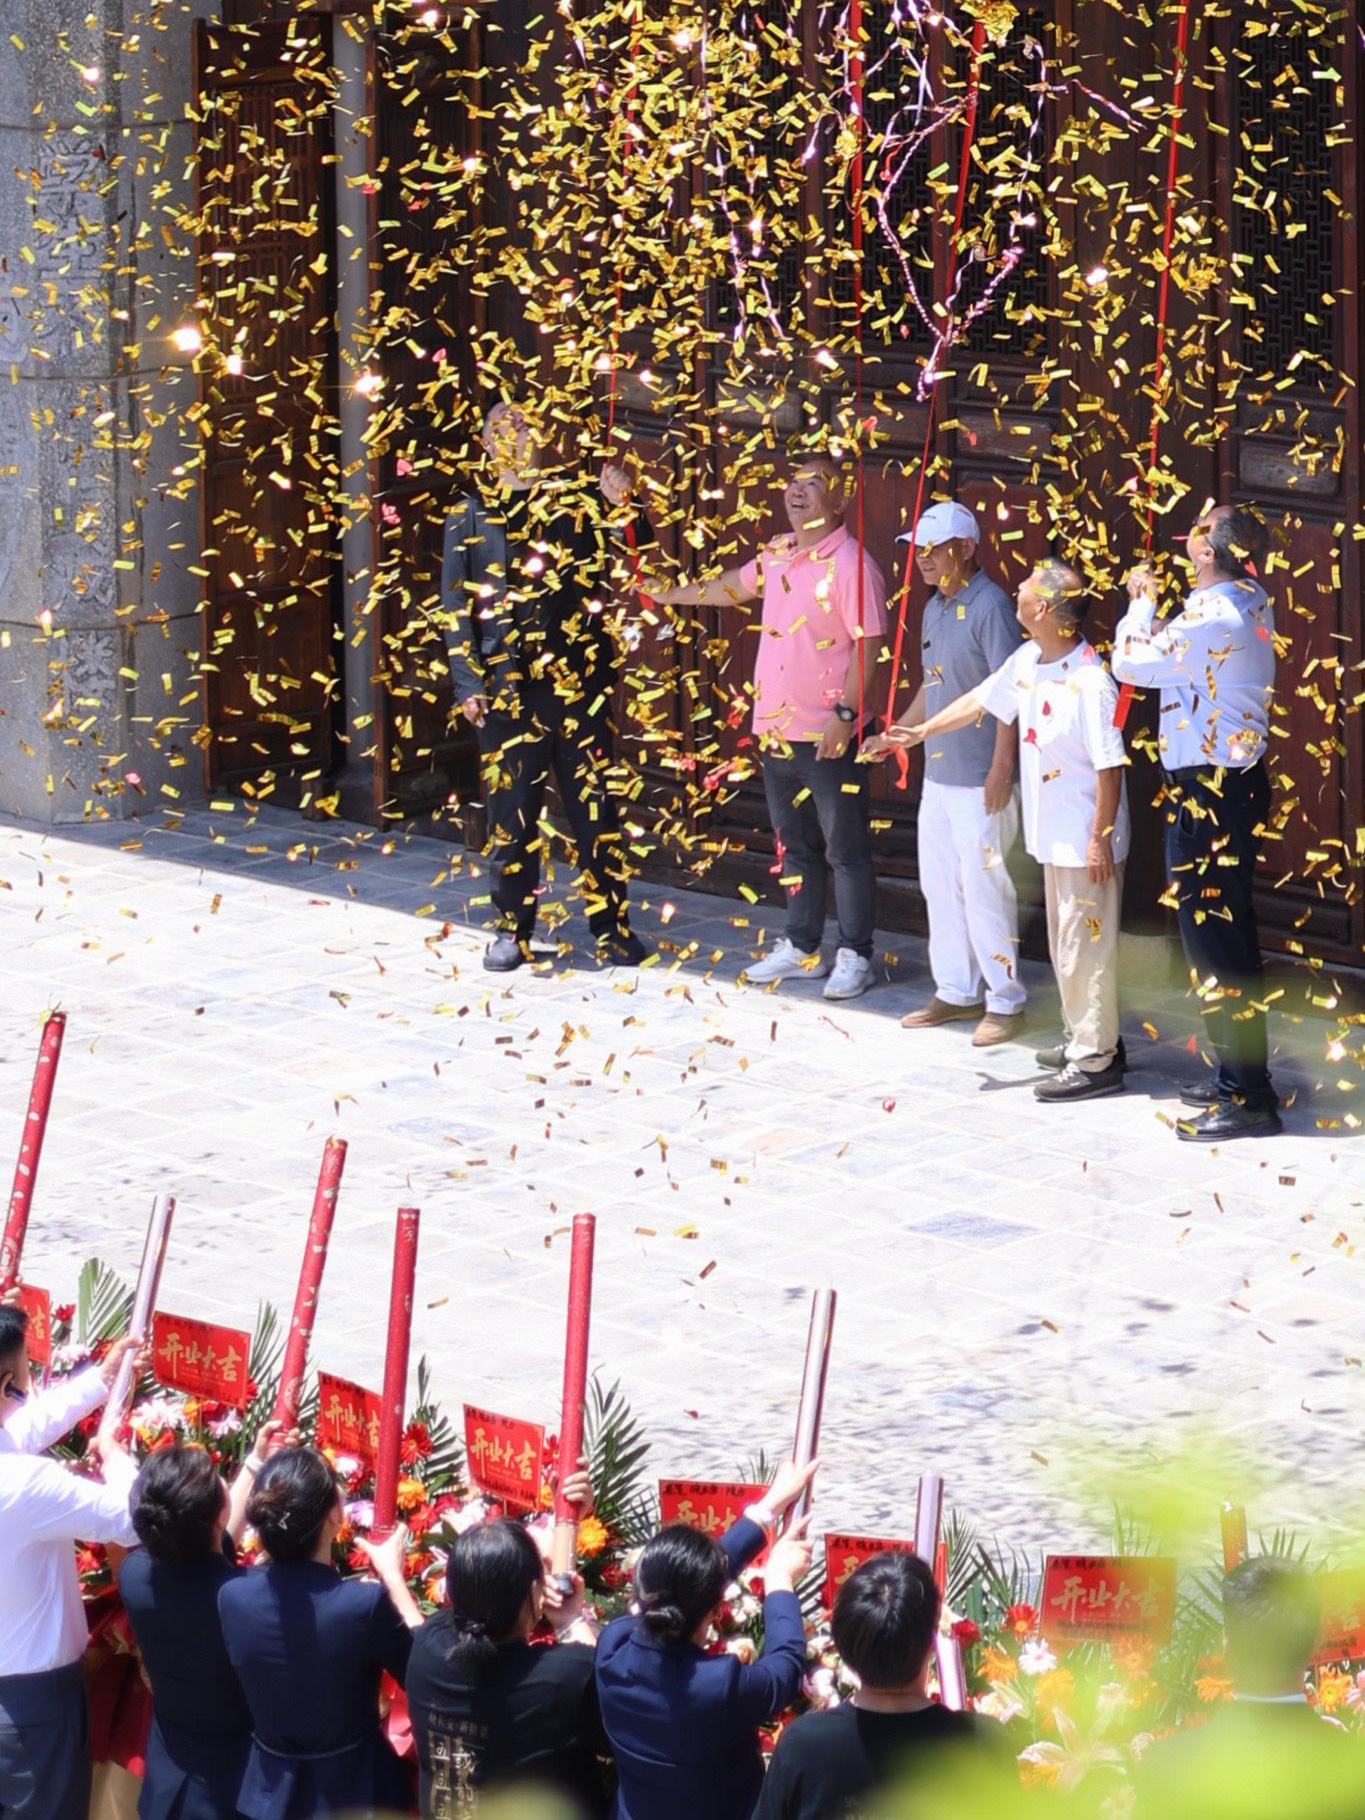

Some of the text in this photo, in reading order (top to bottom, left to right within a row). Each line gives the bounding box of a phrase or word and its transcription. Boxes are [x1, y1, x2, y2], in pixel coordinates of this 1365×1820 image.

[158, 1332, 242, 1381] 开业大吉
[325, 1394, 380, 1448] 开业大吉
[470, 1427, 537, 1480] 开业大吉
[674, 1499, 738, 1532] 开业大
[1050, 1575, 1165, 1624] 开业大吉
